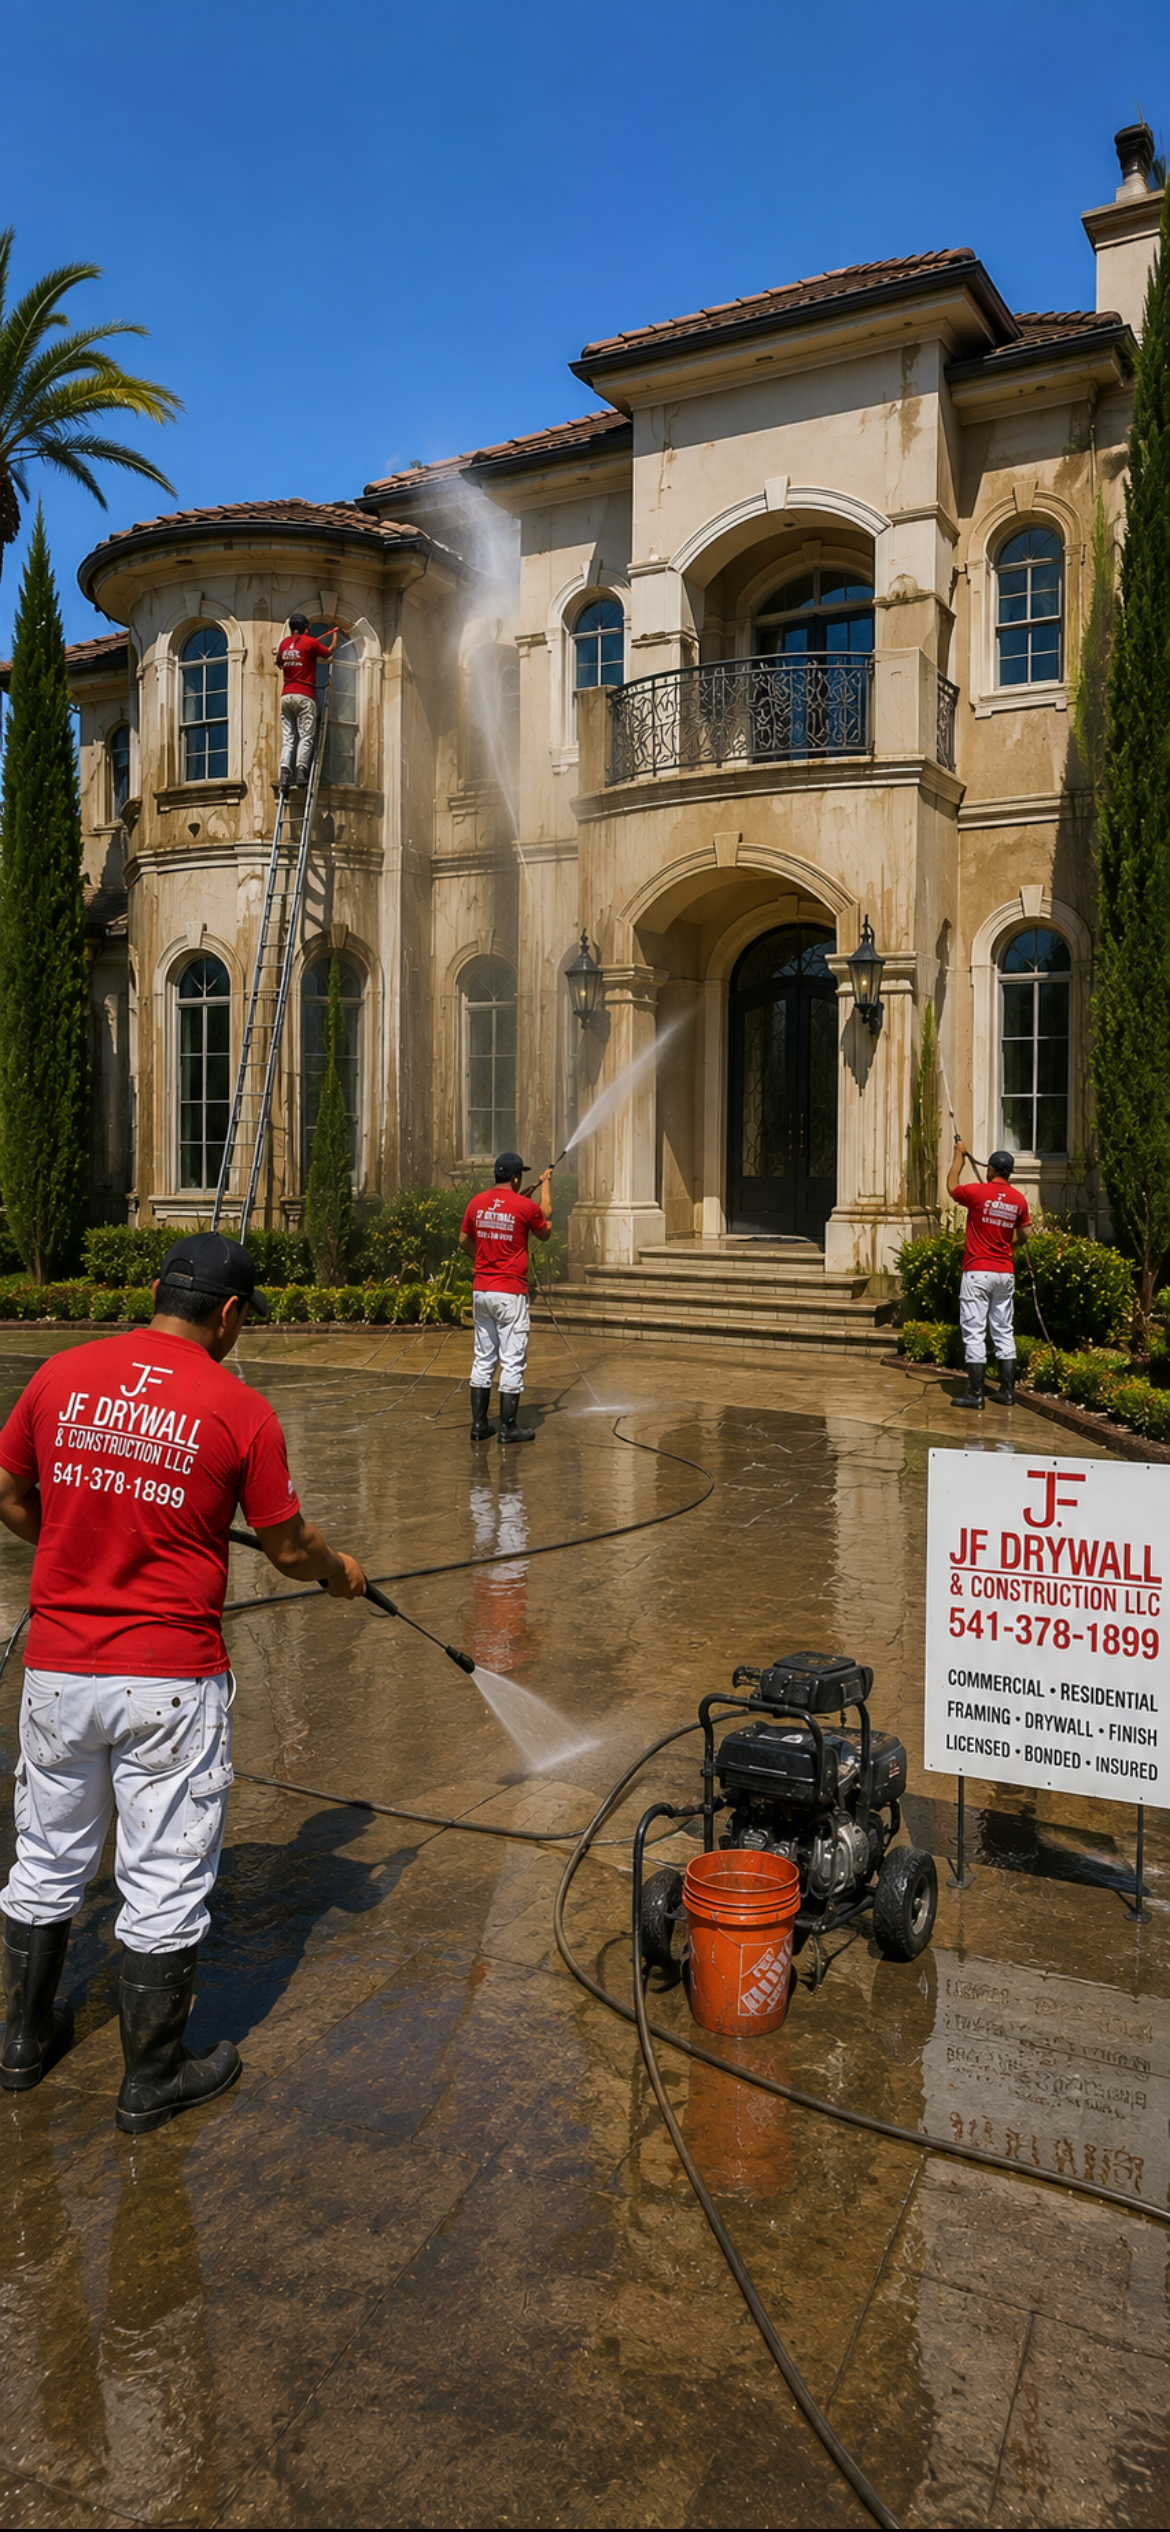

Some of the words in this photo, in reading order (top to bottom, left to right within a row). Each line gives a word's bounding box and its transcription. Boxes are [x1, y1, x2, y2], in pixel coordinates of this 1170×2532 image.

[59, 1392, 89, 1421] JF
[93, 1397, 200, 1449] DRYWALL
[55, 1428, 63, 1447] &
[68, 1429, 162, 1464] CONSTRUCTION
[165, 1451, 194, 1475] LLC
[53, 1462, 185, 1508] 541-378-1899
[949, 1528, 988, 1566] JF
[1001, 1532, 1162, 1583] DRYWALL
[950, 1574, 963, 1596] &
[971, 1576, 1117, 1612] CONSTRUCTION
[1125, 1591, 1160, 1617] LLC
[949, 1607, 1159, 1660] 541-378-1899
[948, 1669, 1045, 1698] COMMERCIAL
[1061, 1683, 1158, 1713] RESIDENTIAL
[948, 1701, 1011, 1725] FRAMING
[1025, 1712, 1093, 1738] DRYWALL
[1109, 1724, 1157, 1747] FINISH
[946, 1734, 1010, 1758] LICENSED
[1025, 1745, 1081, 1769] BONDED
[1096, 1757, 1158, 1781] INSURED
